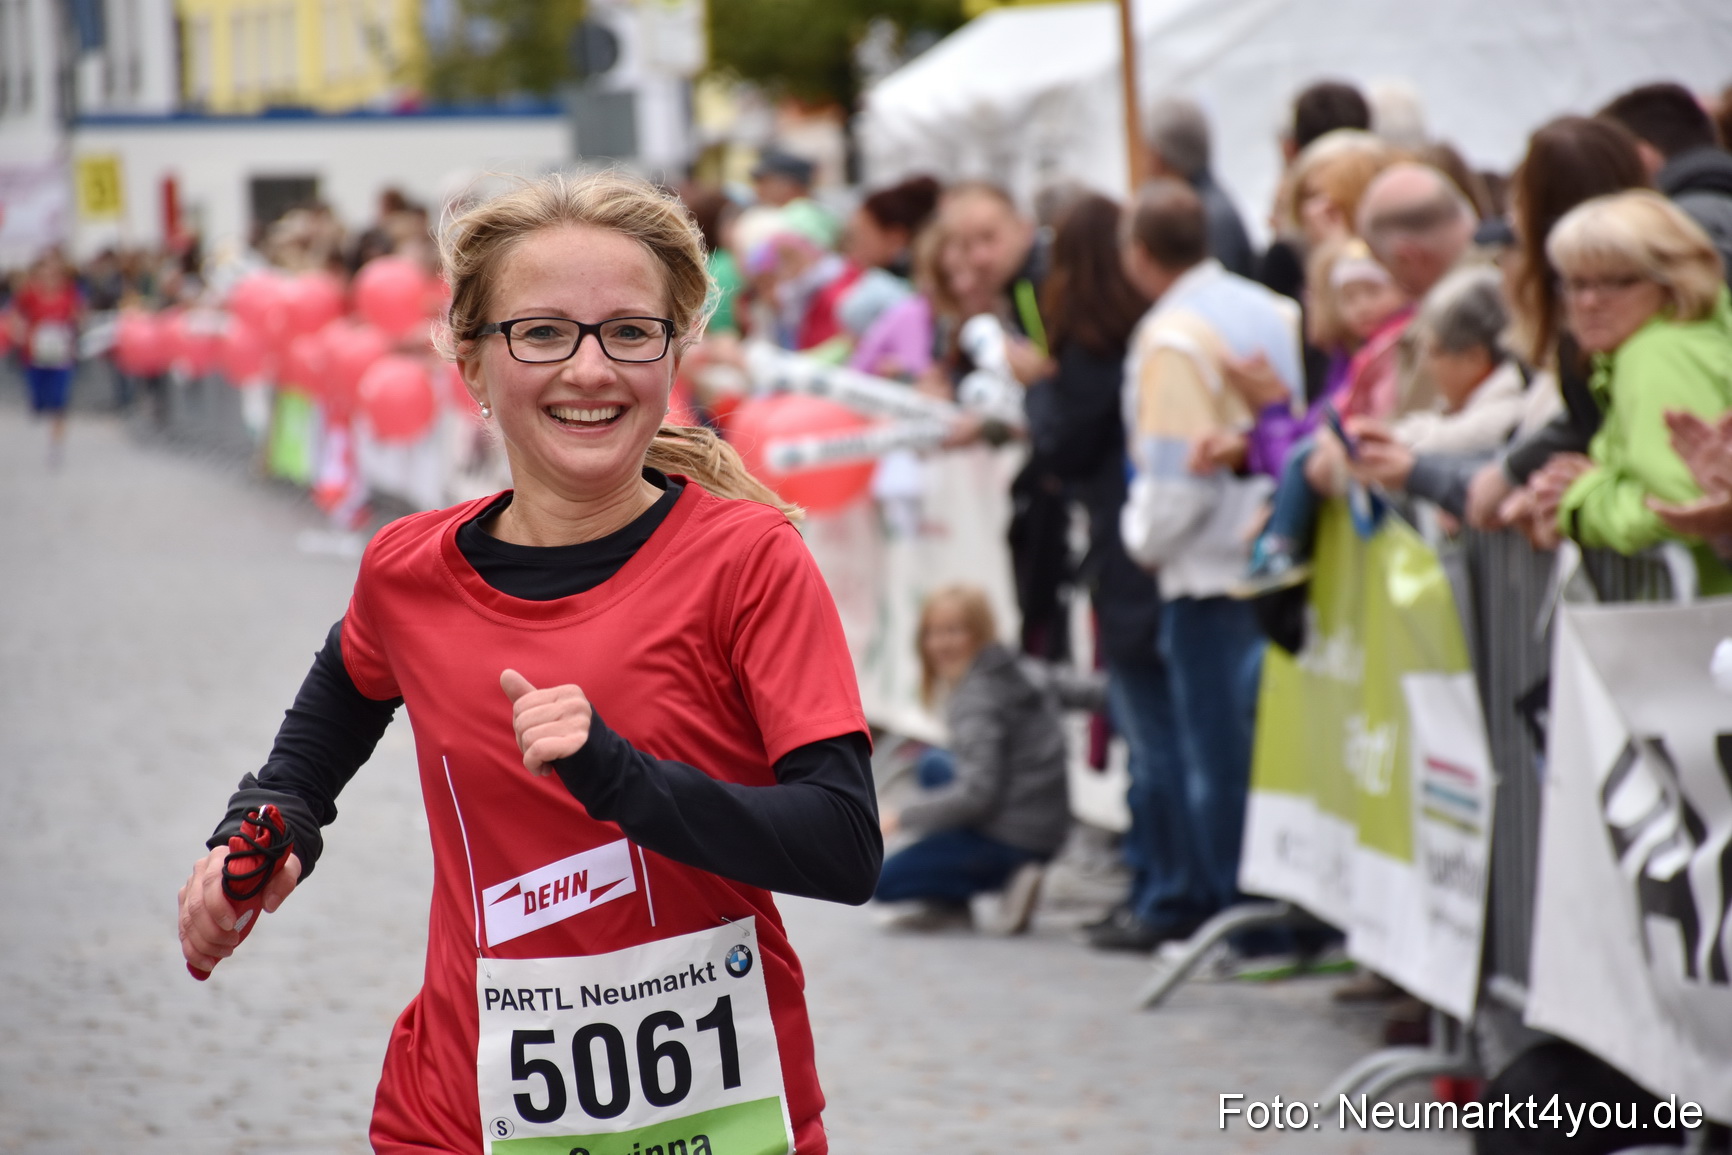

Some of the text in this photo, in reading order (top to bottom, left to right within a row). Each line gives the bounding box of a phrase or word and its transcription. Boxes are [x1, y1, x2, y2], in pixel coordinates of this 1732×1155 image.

[523, 869, 588, 916] DEHN
[484, 961, 717, 1011] PARTL Neumarkt
[510, 994, 742, 1124] 5061
